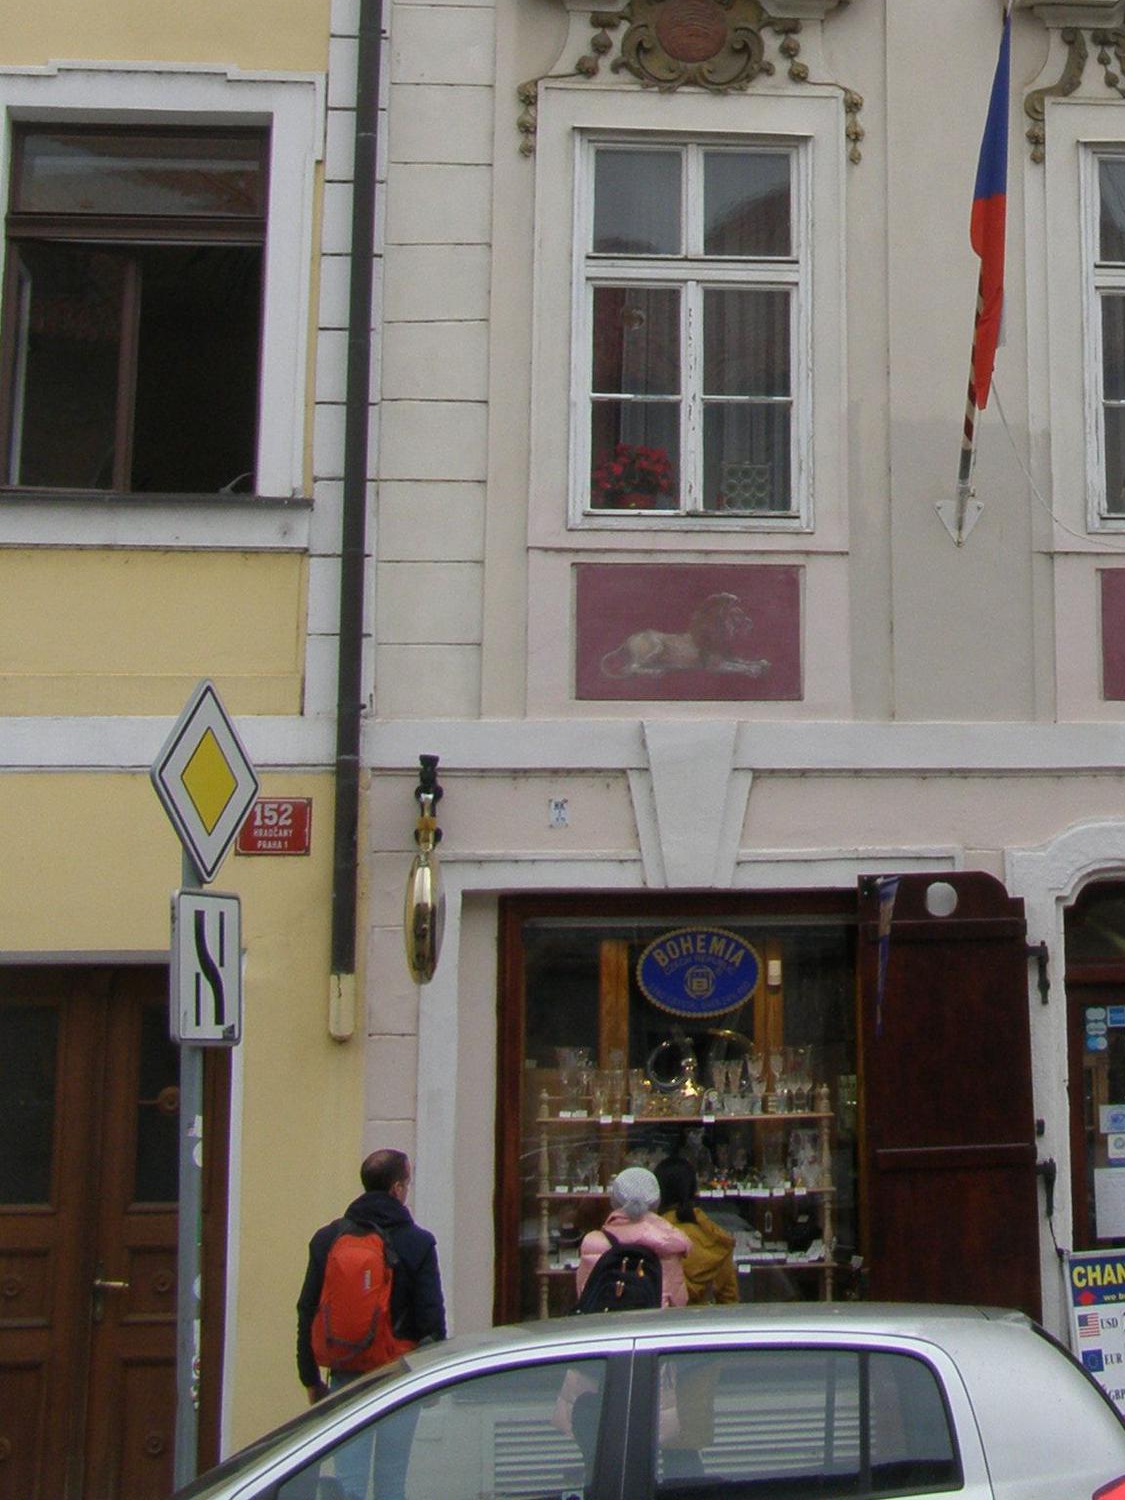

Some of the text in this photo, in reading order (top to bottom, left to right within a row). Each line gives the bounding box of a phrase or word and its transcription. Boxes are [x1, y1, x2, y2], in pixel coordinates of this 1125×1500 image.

[253, 803, 293, 826] 152
[257, 840, 282, 849] PRAHA
[652, 934, 746, 967] BOHEMIA
[1103, 1293, 1117, 1301] we
[1100, 1317, 1119, 1329] USD
[1104, 1353, 1122, 1364] EUR
[1109, 1389, 1125, 1400] GBP
